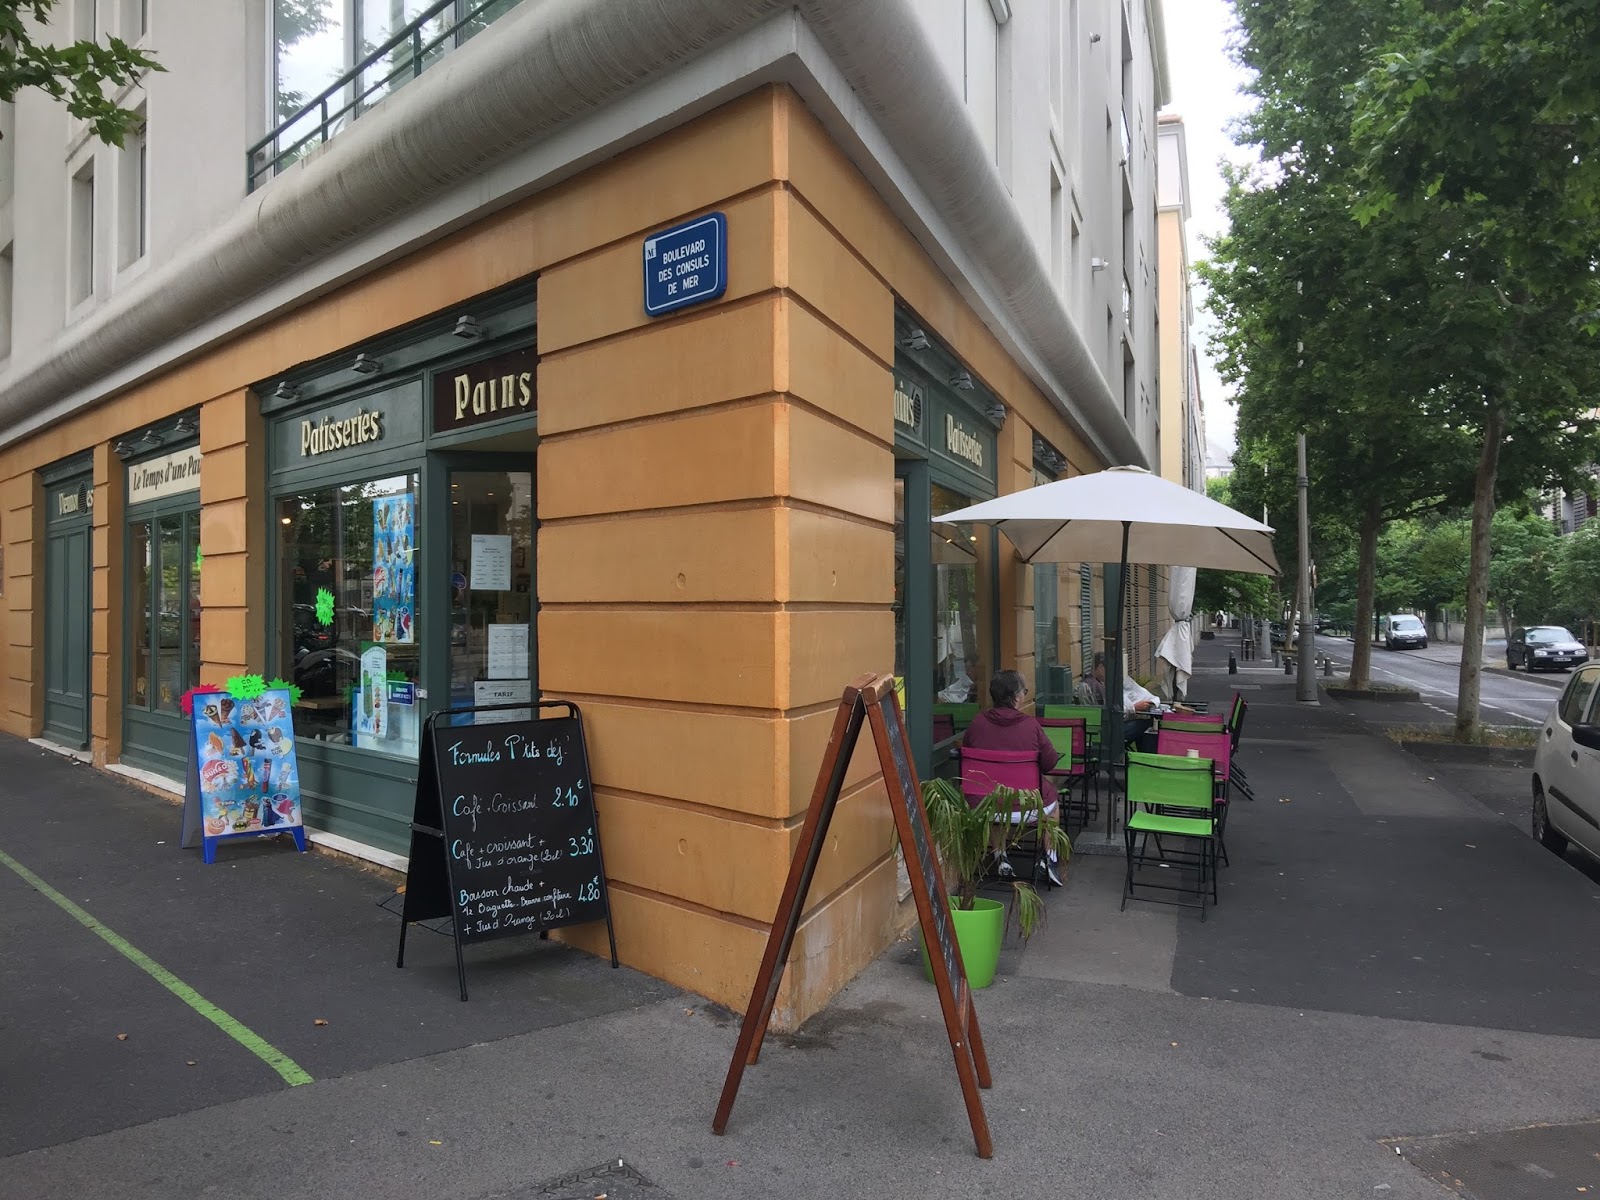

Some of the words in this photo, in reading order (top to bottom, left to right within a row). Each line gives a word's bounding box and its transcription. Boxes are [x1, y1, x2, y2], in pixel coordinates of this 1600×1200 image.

[662, 239, 705, 265] BOULEVARD
[658, 268, 672, 282] DES
[676, 254, 709, 276] CONSULS
[668, 282, 677, 295] DE
[682, 275, 699, 290] MER
[454, 371, 532, 420] Pains
[301, 407, 380, 456] Patisseries
[133, 472, 141, 490] Le
[142, 469, 163, 490] Temps
[165, 461, 187, 483] d'une
[448, 740, 500, 765] Formules
[453, 794, 482, 832] Café
[452, 839, 475, 869] Café
[487, 833, 536, 853] croissant
[502, 875, 534, 895] chaude
